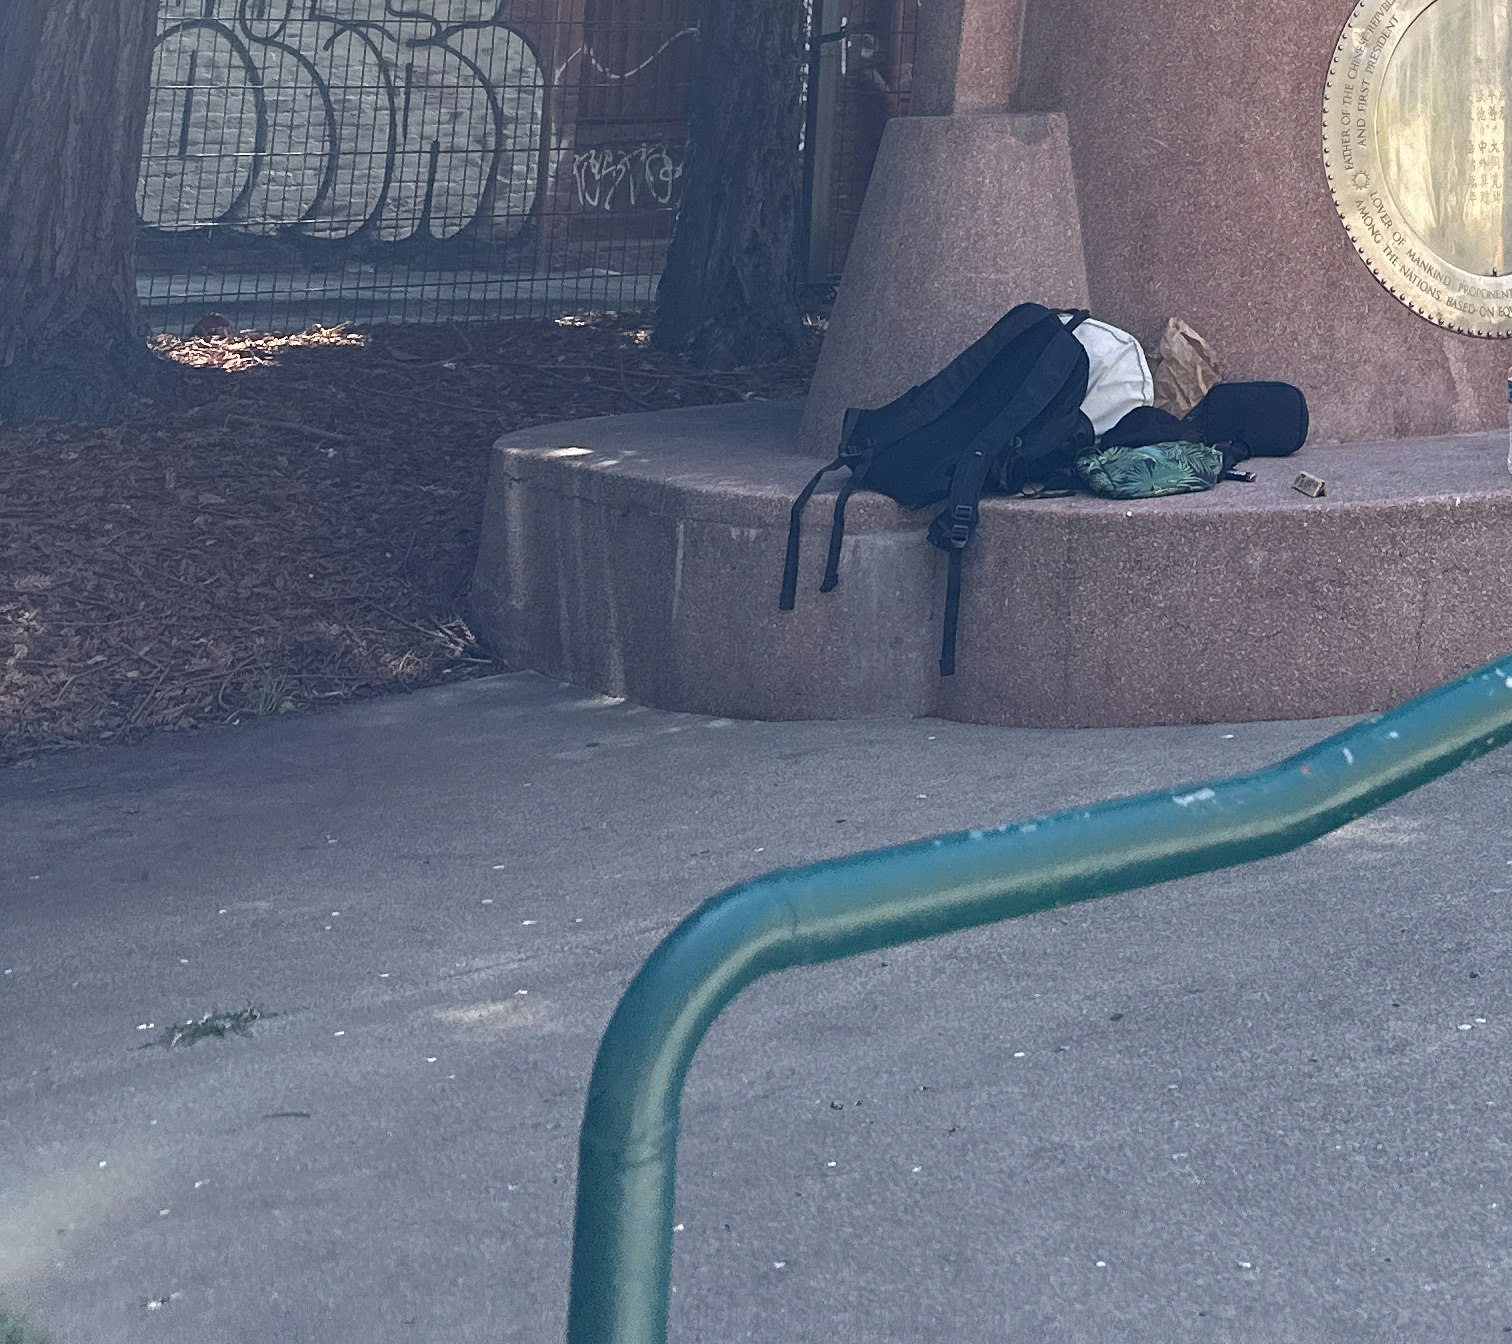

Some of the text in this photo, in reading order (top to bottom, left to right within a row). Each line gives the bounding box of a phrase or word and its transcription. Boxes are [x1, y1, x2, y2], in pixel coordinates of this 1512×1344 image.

[1347, 31, 1371, 80] CHINESE
[1342, 83, 1354, 105] THE
[1356, 14, 1399, 148] AND FIRST PRESIDENT
[1340, 109, 1351, 126] OF
[1341, 128, 1355, 171] FATHER
[1355, 199, 1384, 244] AMONG
[1382, 243, 1399, 267] THE
[1446, 296, 1476, 314] BASED
[1479, 305, 1495, 318] ON
[1369, 190, 1393, 229] LOVER
[1393, 231, 1406, 247] OF
[1406, 248, 1452, 287] MANKIND
